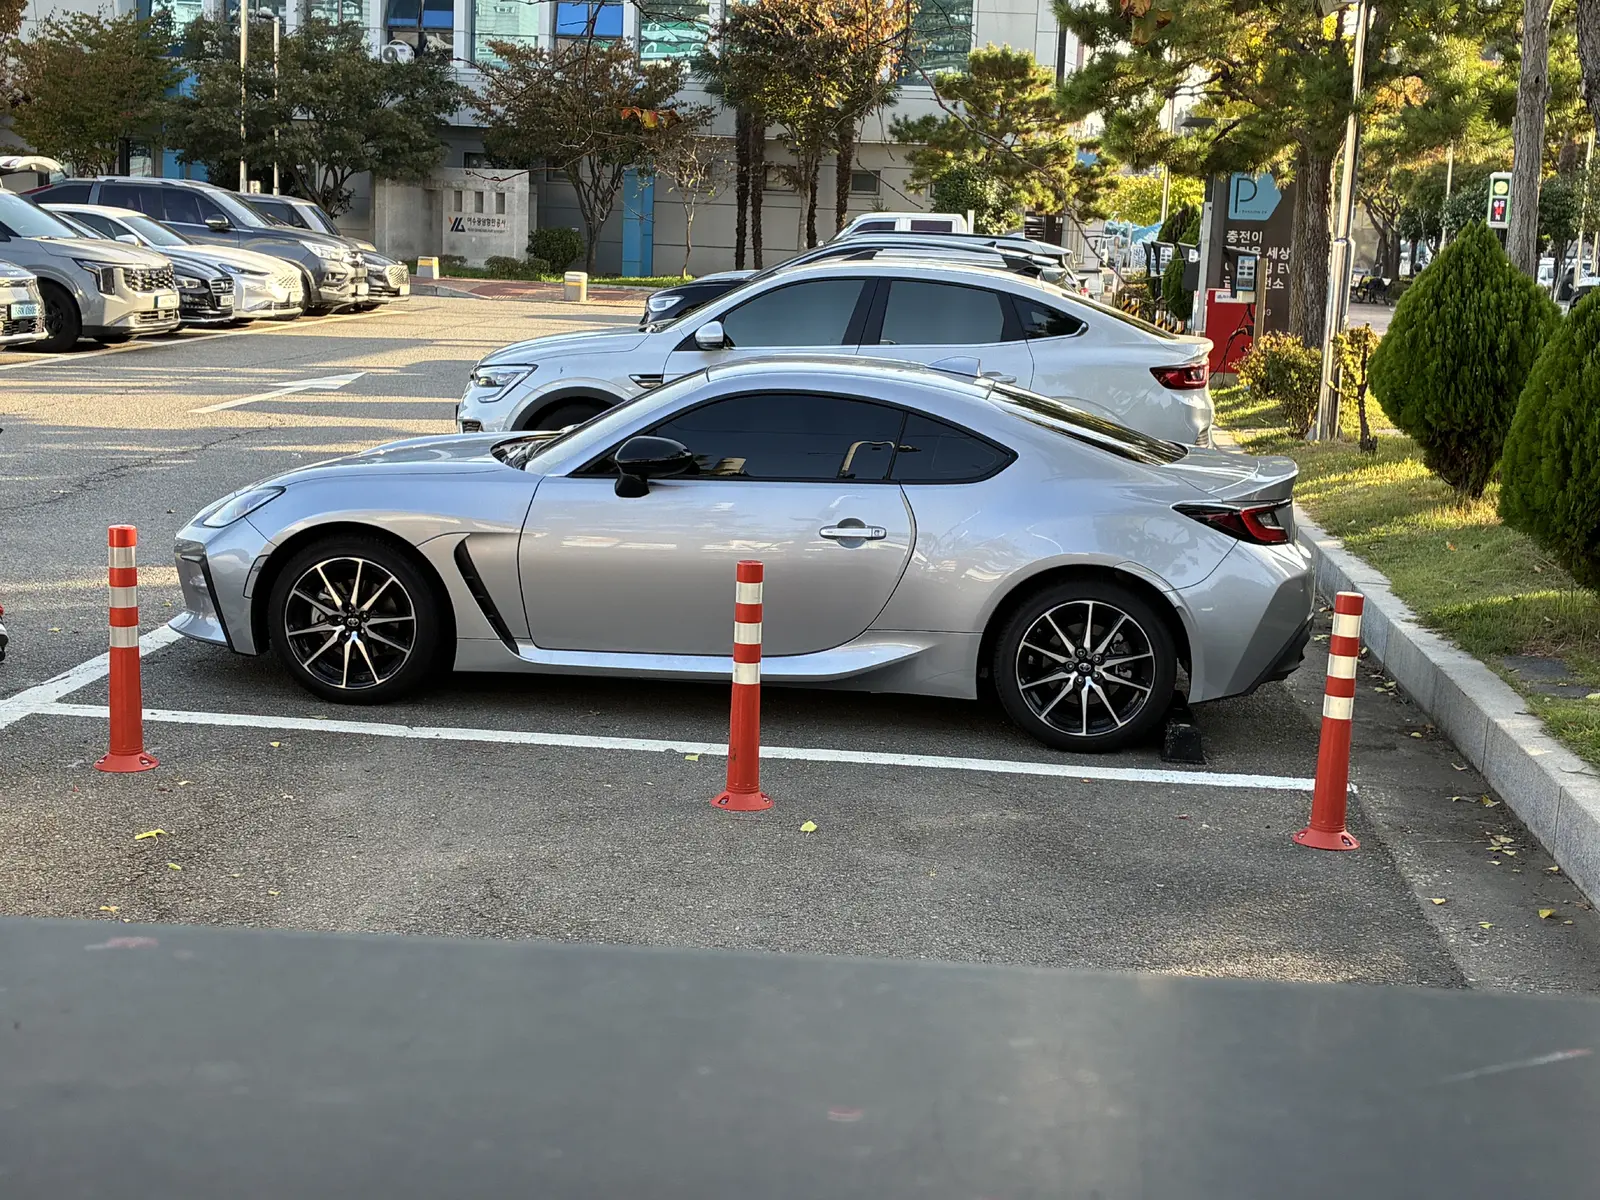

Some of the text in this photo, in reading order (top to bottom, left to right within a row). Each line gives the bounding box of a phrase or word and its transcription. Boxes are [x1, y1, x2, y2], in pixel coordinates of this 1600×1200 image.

[1234, 177, 1258, 214] P
[1226, 230, 1263, 244] 충전이
[1266, 246, 1291, 260] 세상
